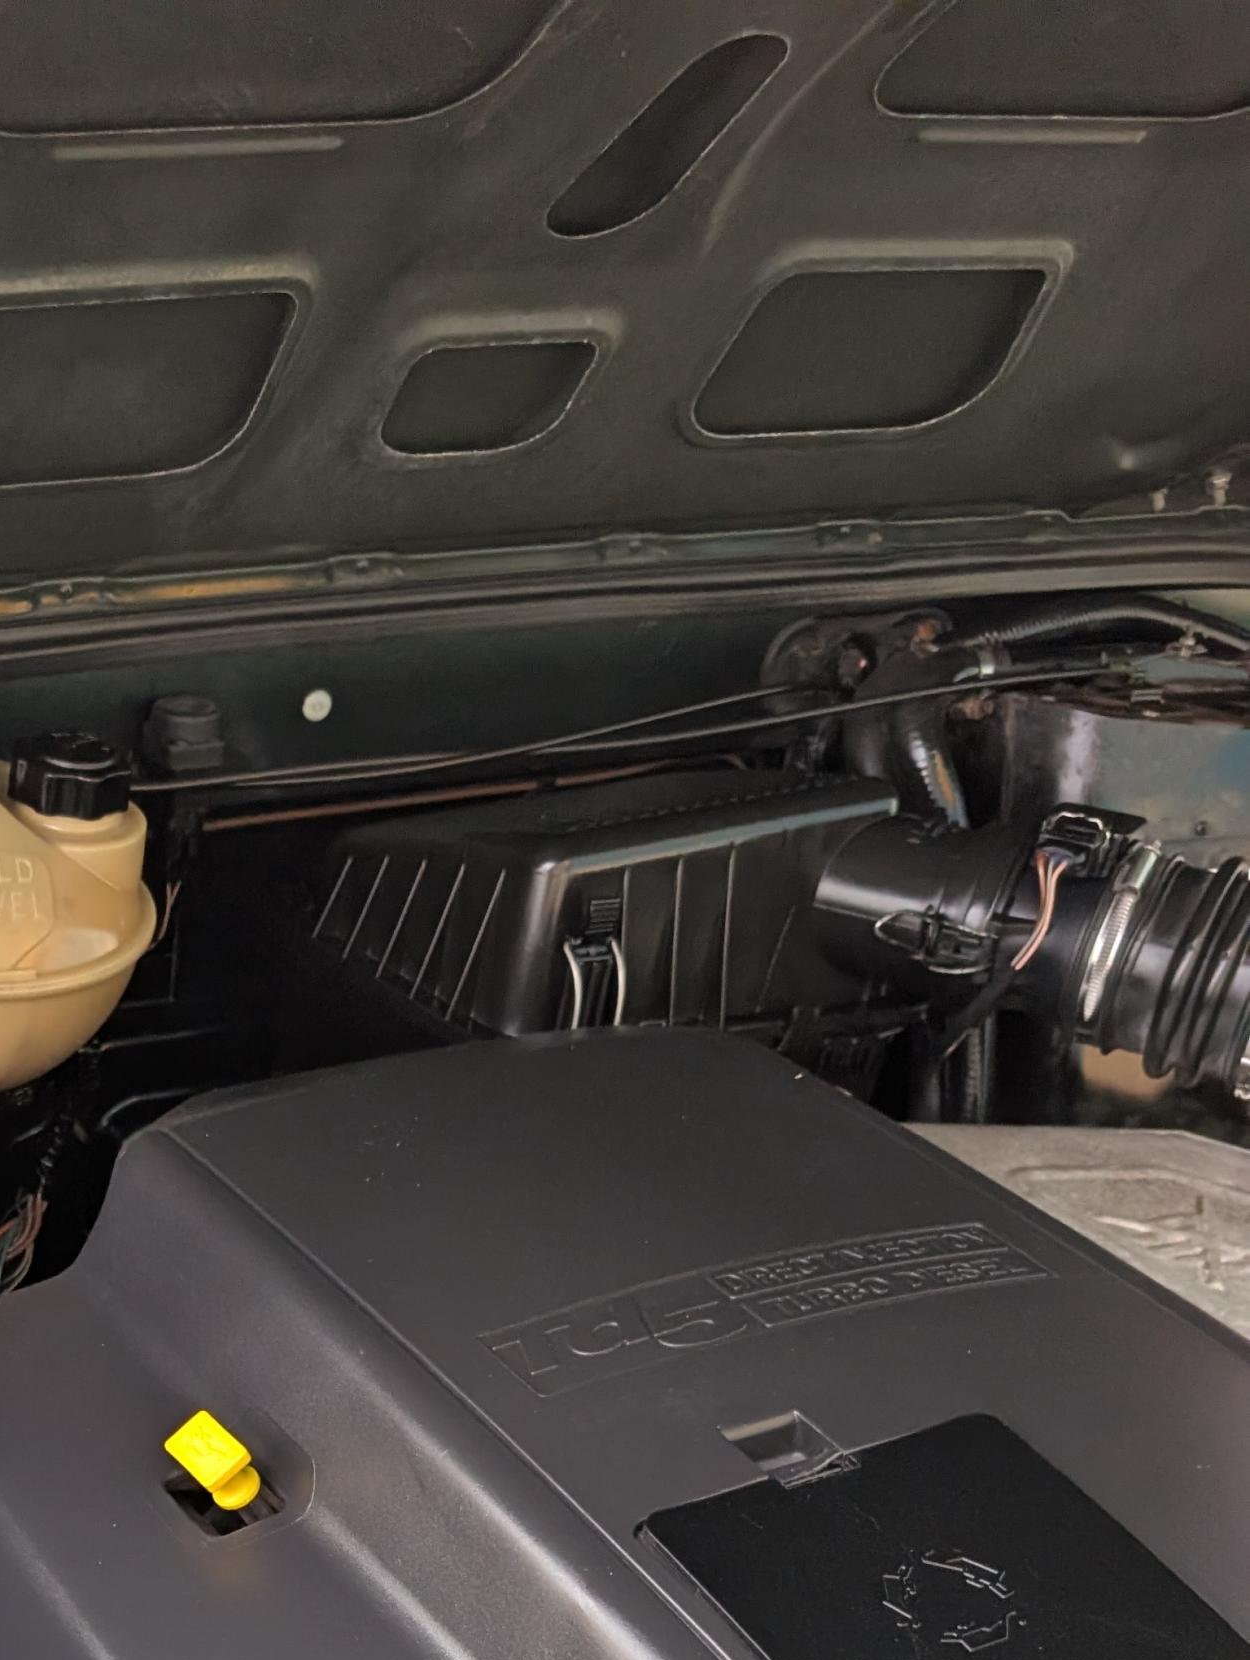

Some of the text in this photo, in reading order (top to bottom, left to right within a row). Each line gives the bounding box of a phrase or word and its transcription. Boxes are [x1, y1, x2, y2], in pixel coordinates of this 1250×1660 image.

[715, 1253, 826, 1291] DIRECT
[758, 1257, 1029, 1316] TURBO DIESEL
